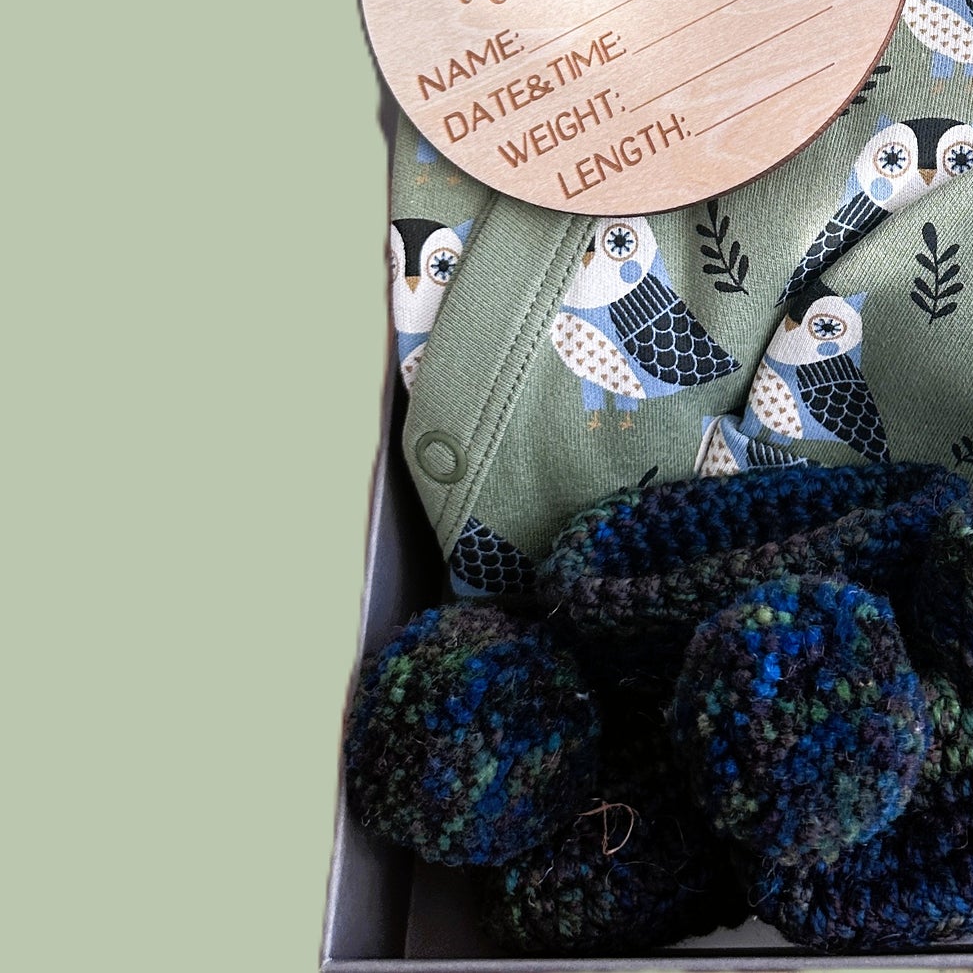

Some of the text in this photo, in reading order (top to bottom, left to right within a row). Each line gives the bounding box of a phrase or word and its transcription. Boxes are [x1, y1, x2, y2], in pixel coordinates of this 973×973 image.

[416, 28, 526, 101] NAME:
[442, 30, 628, 144] DATE&TIME:
[497, 87, 626, 169] WEIGHT:
[556, 112, 692, 200] LENGTH:
